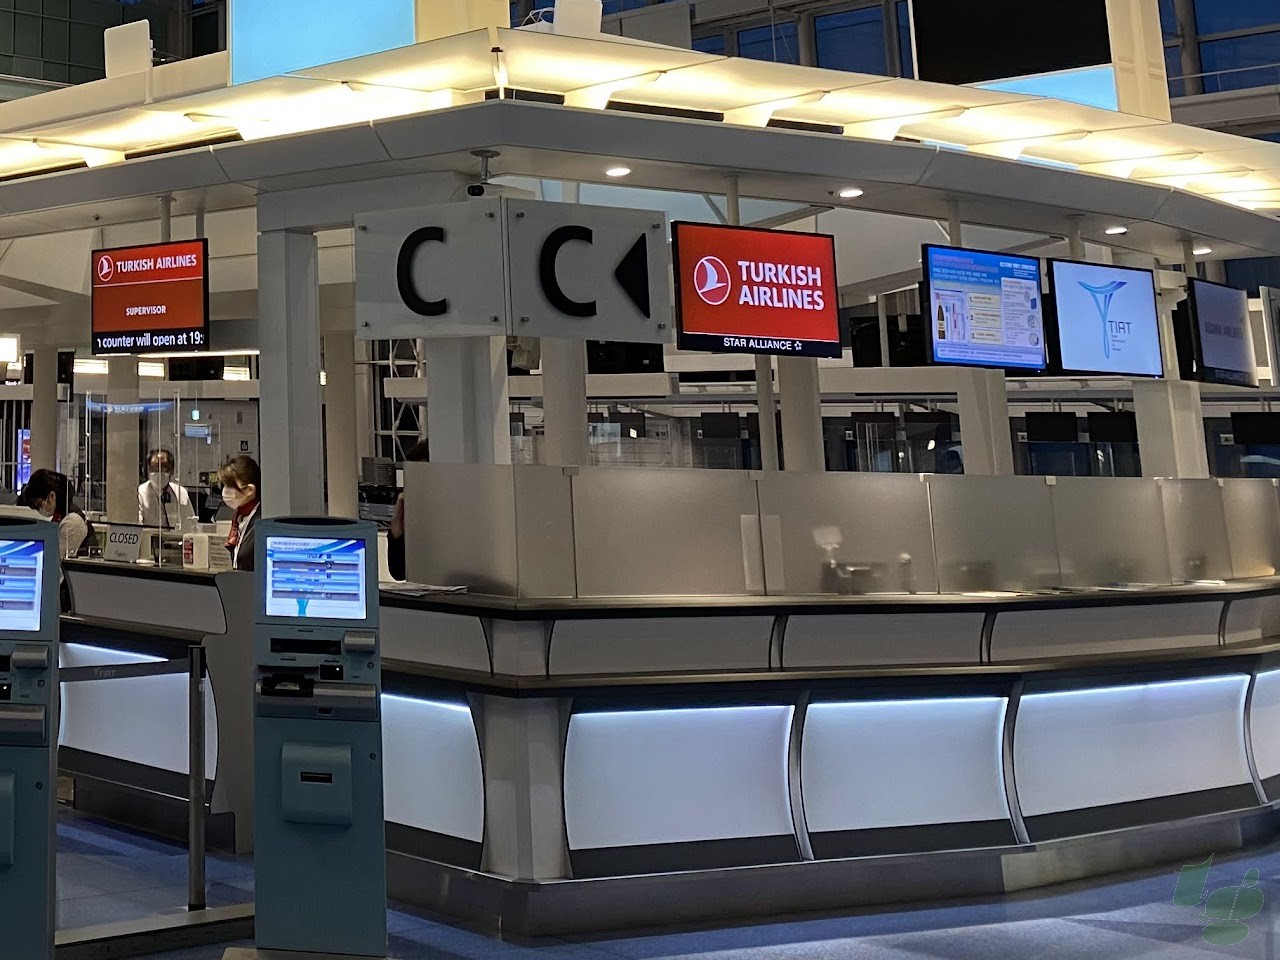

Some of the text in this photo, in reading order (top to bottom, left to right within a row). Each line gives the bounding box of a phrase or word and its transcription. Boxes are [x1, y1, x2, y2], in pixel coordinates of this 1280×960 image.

[116, 254, 197, 273] TURKISH AIRLINES
[396, 226, 449, 316] C
[539, 225, 597, 318] C
[738, 261, 822, 287] TURKISH
[738, 285, 825, 311] AIRLINES
[125, 305, 166, 316] SUPERVISOR
[1108, 320, 1132, 334] TIAT
[102, 335, 134, 348] counter
[136, 332, 151, 346] will
[153, 335, 176, 346] open
[177, 332, 188, 345] at
[723, 337, 792, 350] STAR ALLIANCE
[109, 532, 139, 545] CLOSED
